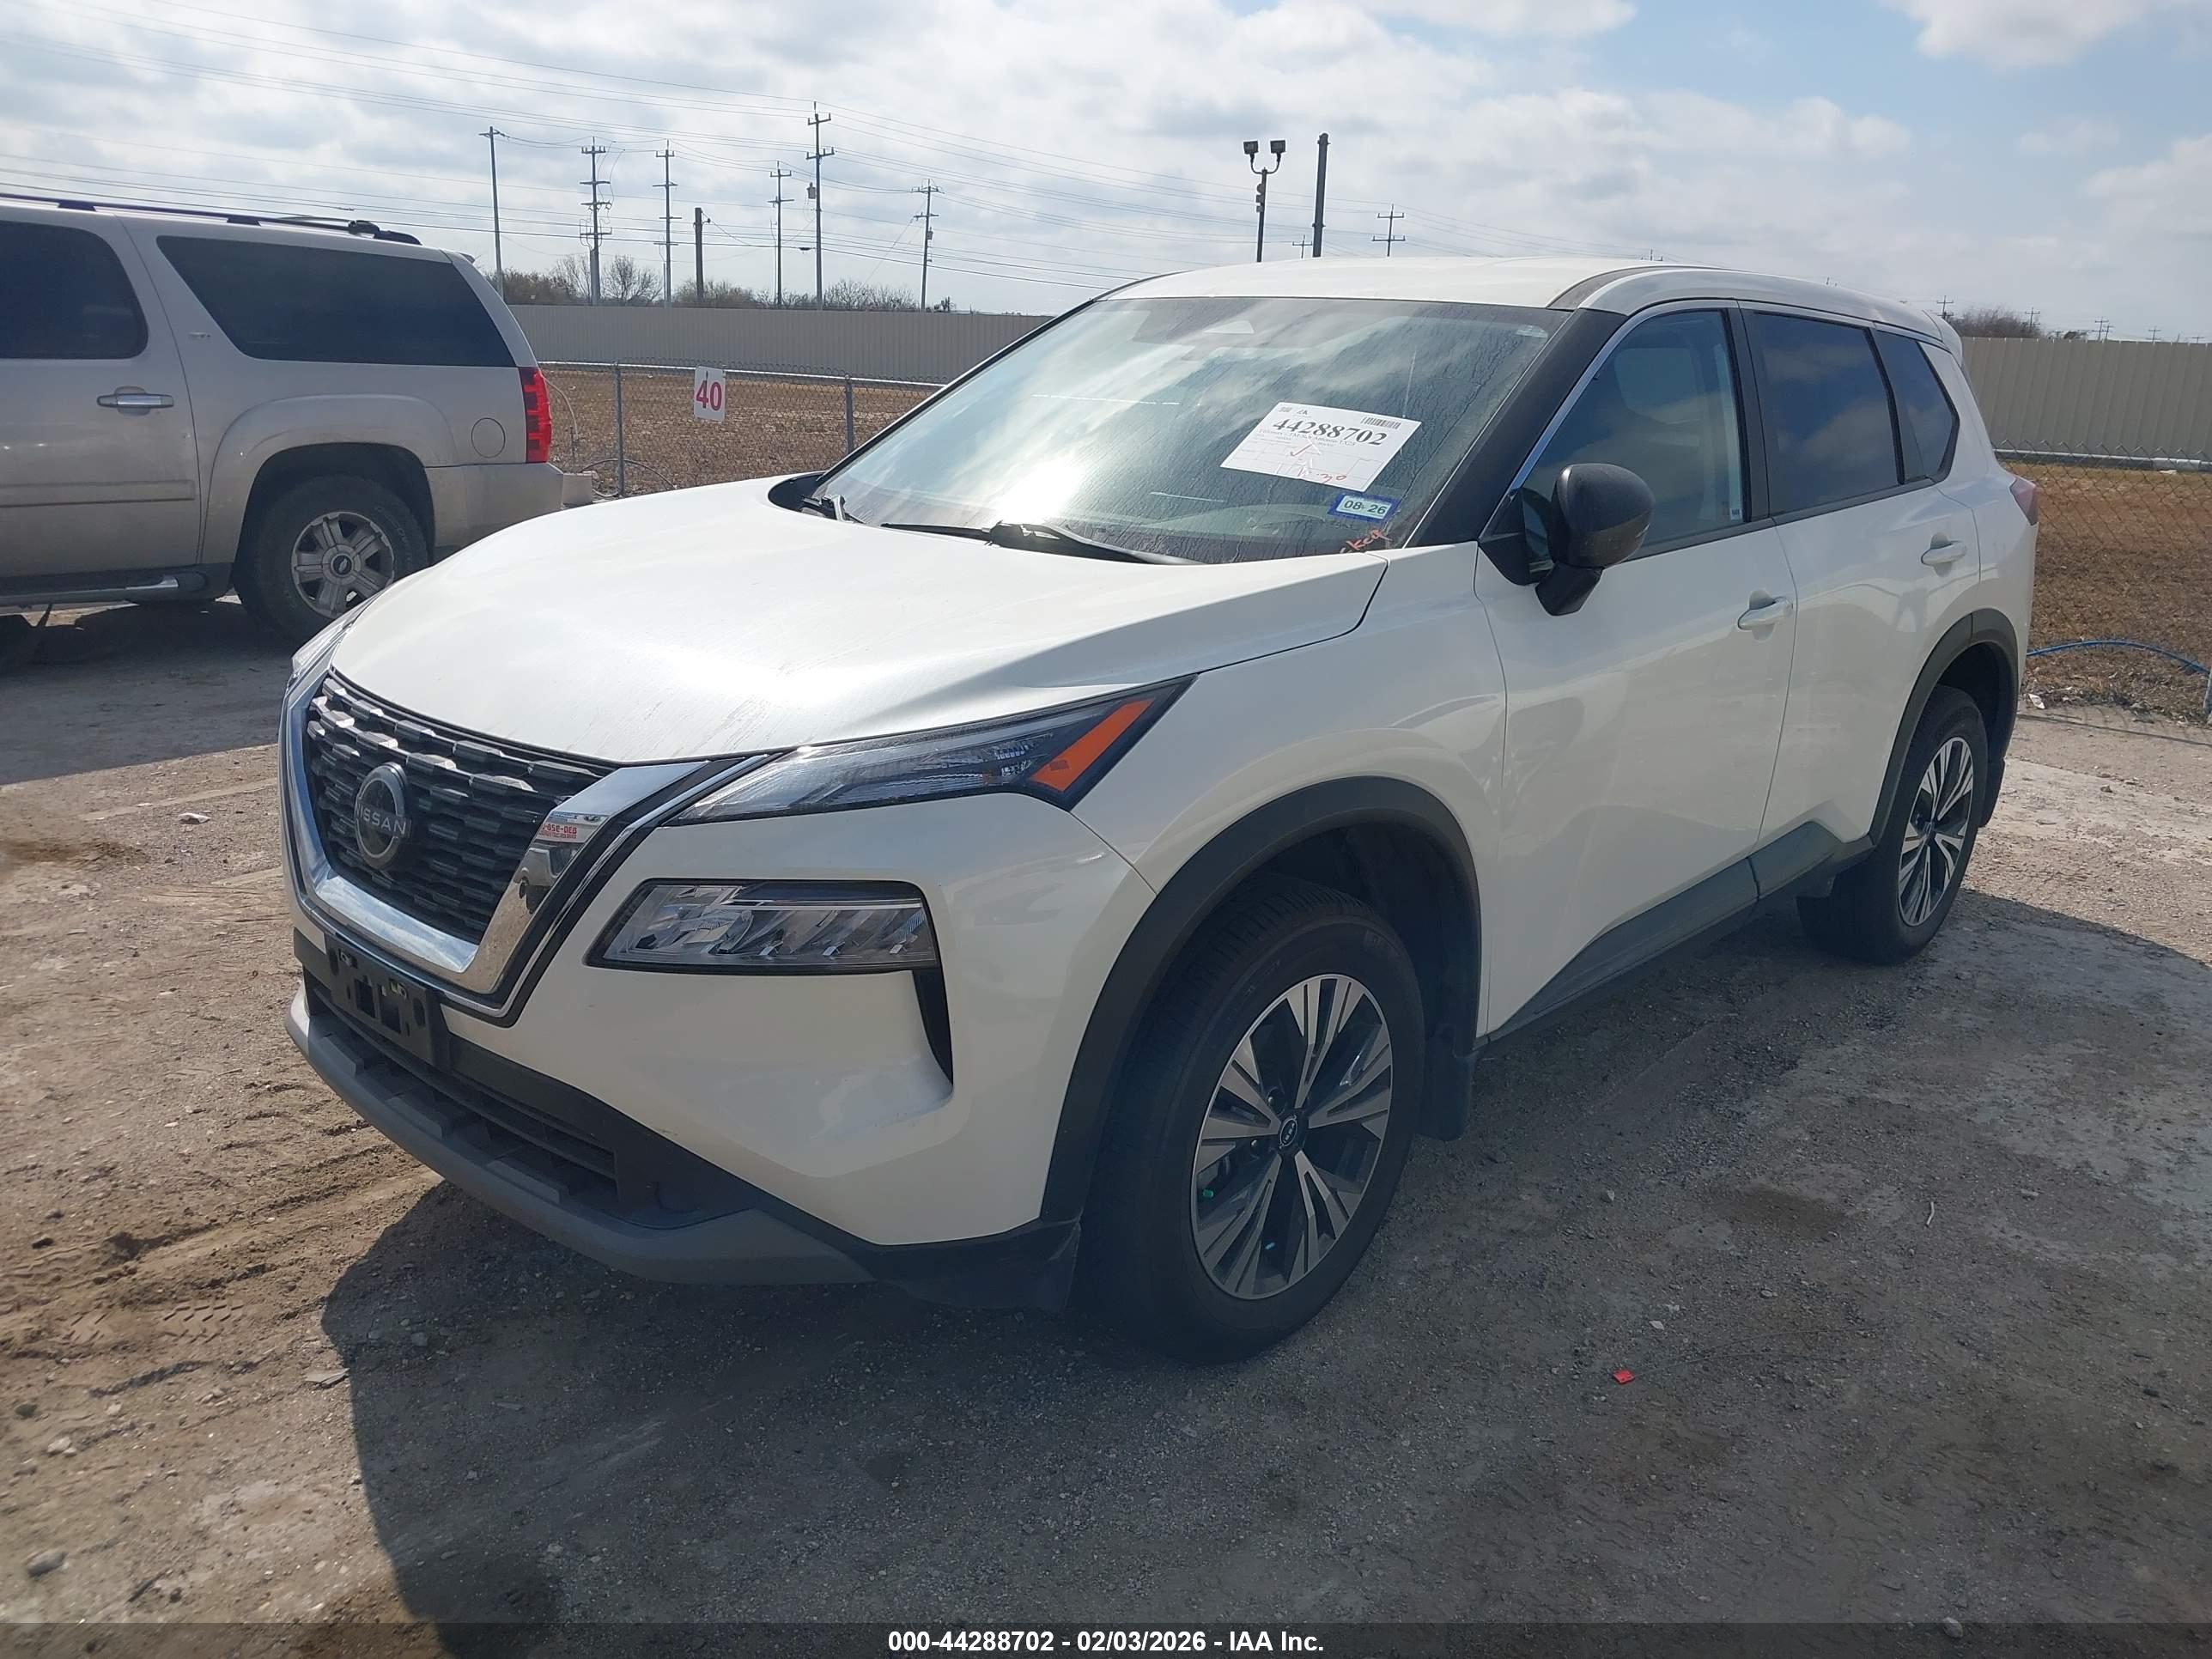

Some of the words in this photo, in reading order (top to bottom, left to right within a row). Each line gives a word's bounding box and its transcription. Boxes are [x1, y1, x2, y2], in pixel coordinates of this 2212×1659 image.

[696, 380, 722, 410] 40
[1273, 419, 1388, 446] 44288702
[355, 803, 407, 835] NISSAN
